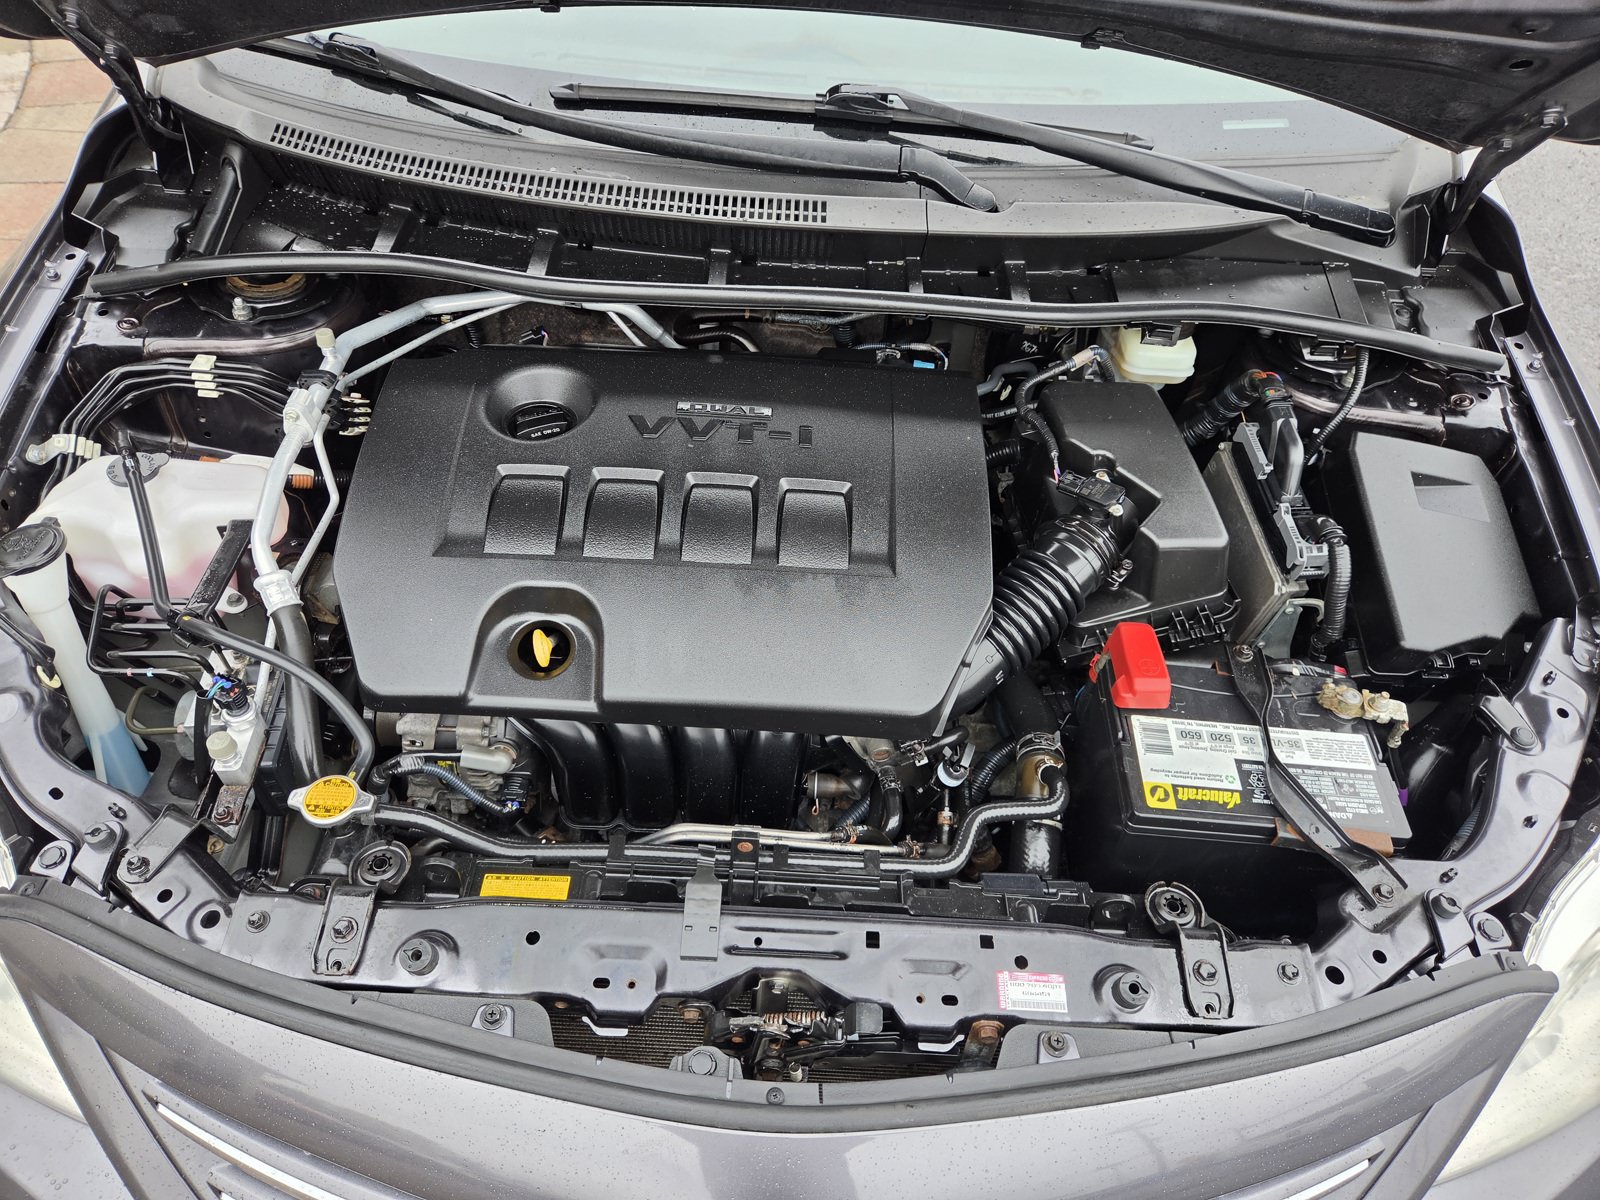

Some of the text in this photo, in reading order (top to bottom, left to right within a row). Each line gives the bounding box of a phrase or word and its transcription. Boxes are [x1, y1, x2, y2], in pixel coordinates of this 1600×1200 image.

[689, 402, 765, 415] DUAL
[1180, 730, 1202, 740] 650
[1210, 732, 1232, 742] 520
[1242, 736, 1256, 744] 35
[1176, 787, 1241, 808] Valucraft
